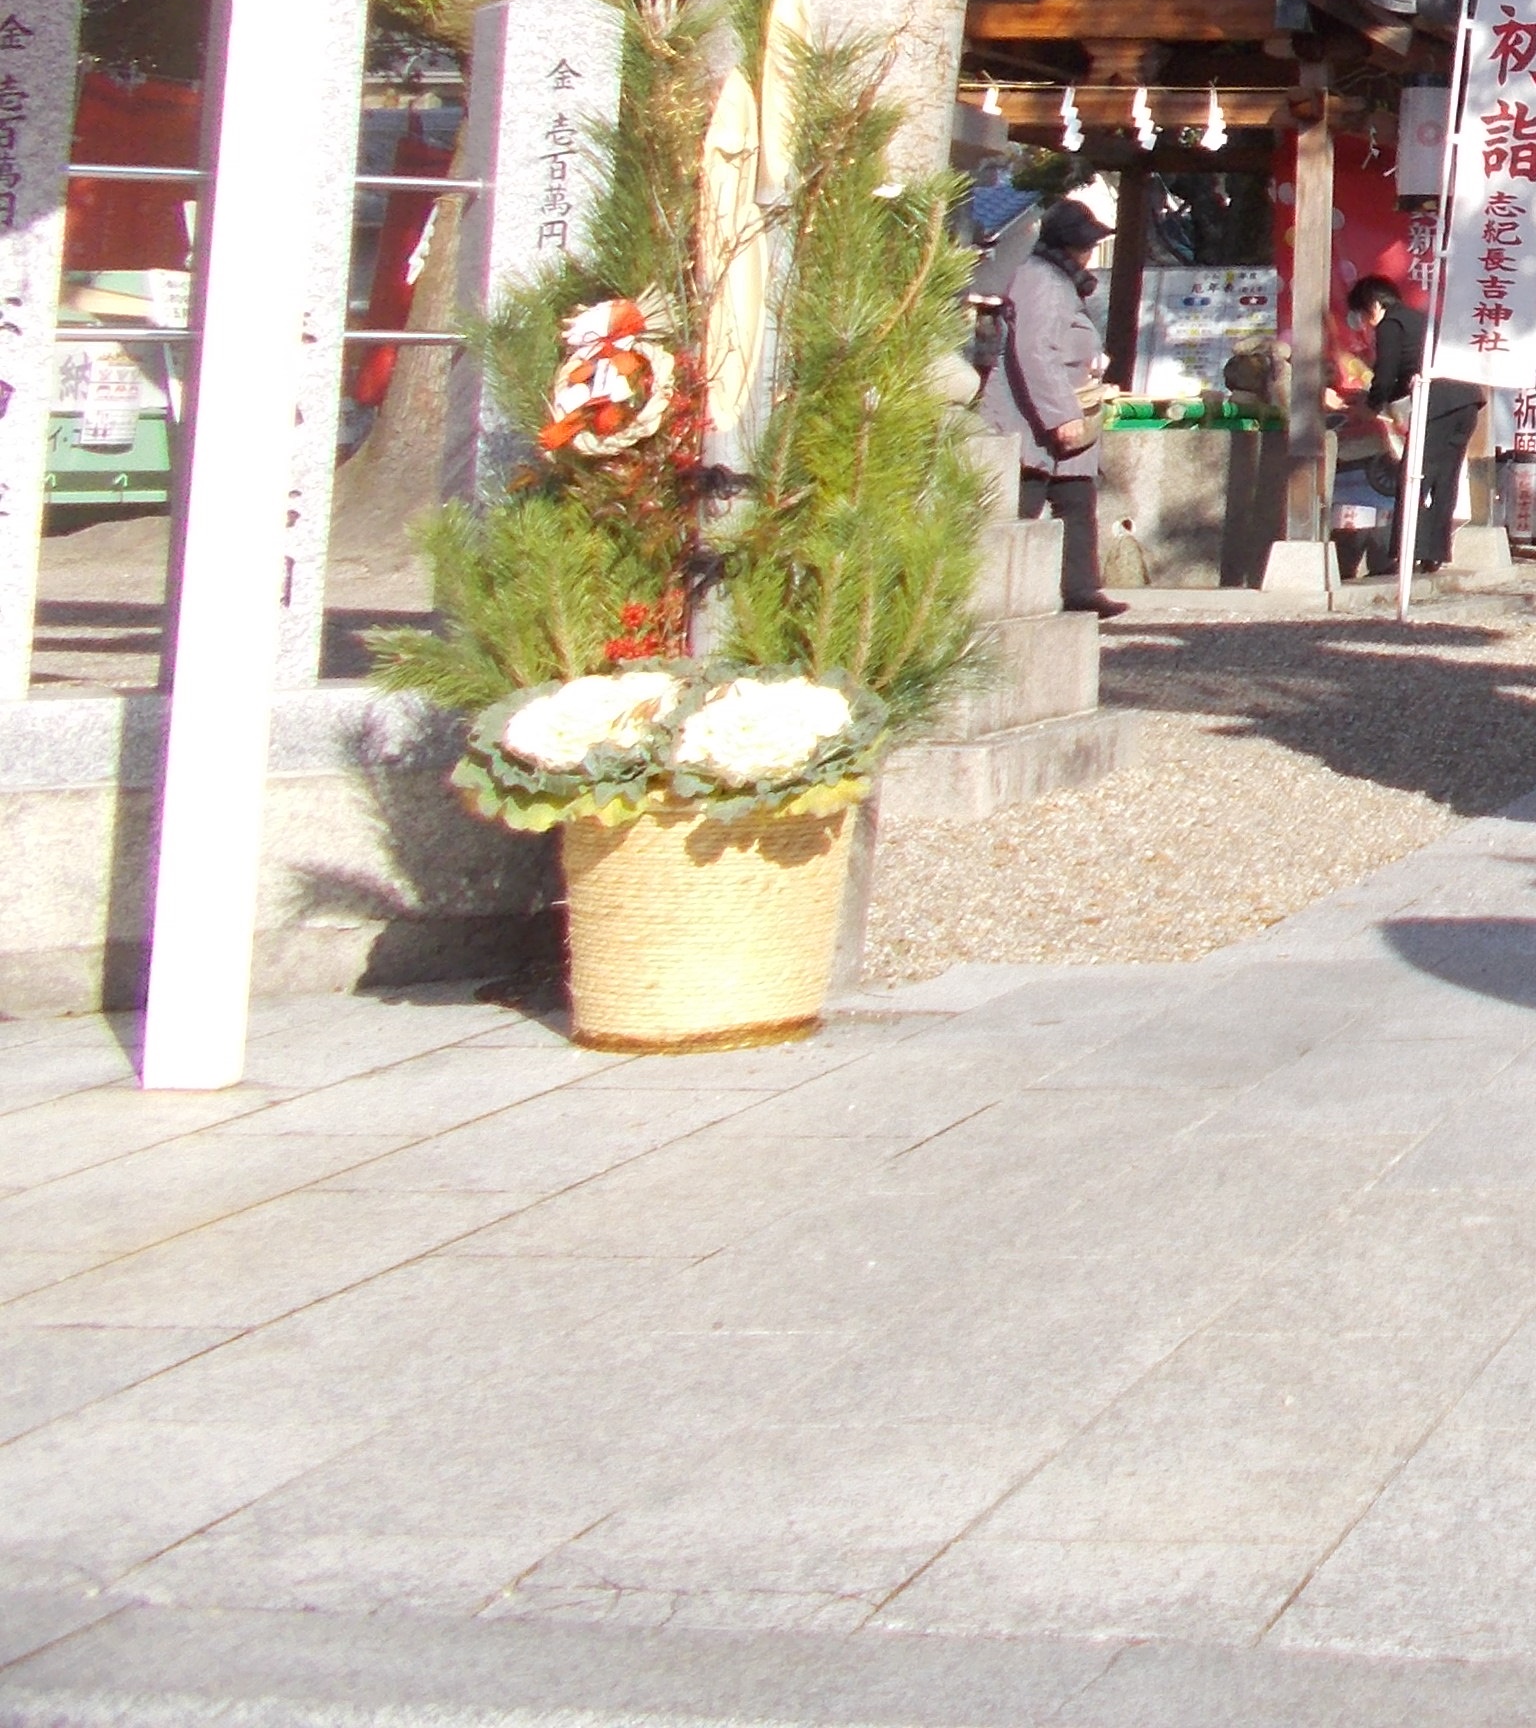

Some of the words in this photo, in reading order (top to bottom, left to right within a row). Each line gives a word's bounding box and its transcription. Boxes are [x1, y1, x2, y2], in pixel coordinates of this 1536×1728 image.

[546, 57, 582, 91] 金
[1470, 191, 1527, 353] 志紀長吉神社
